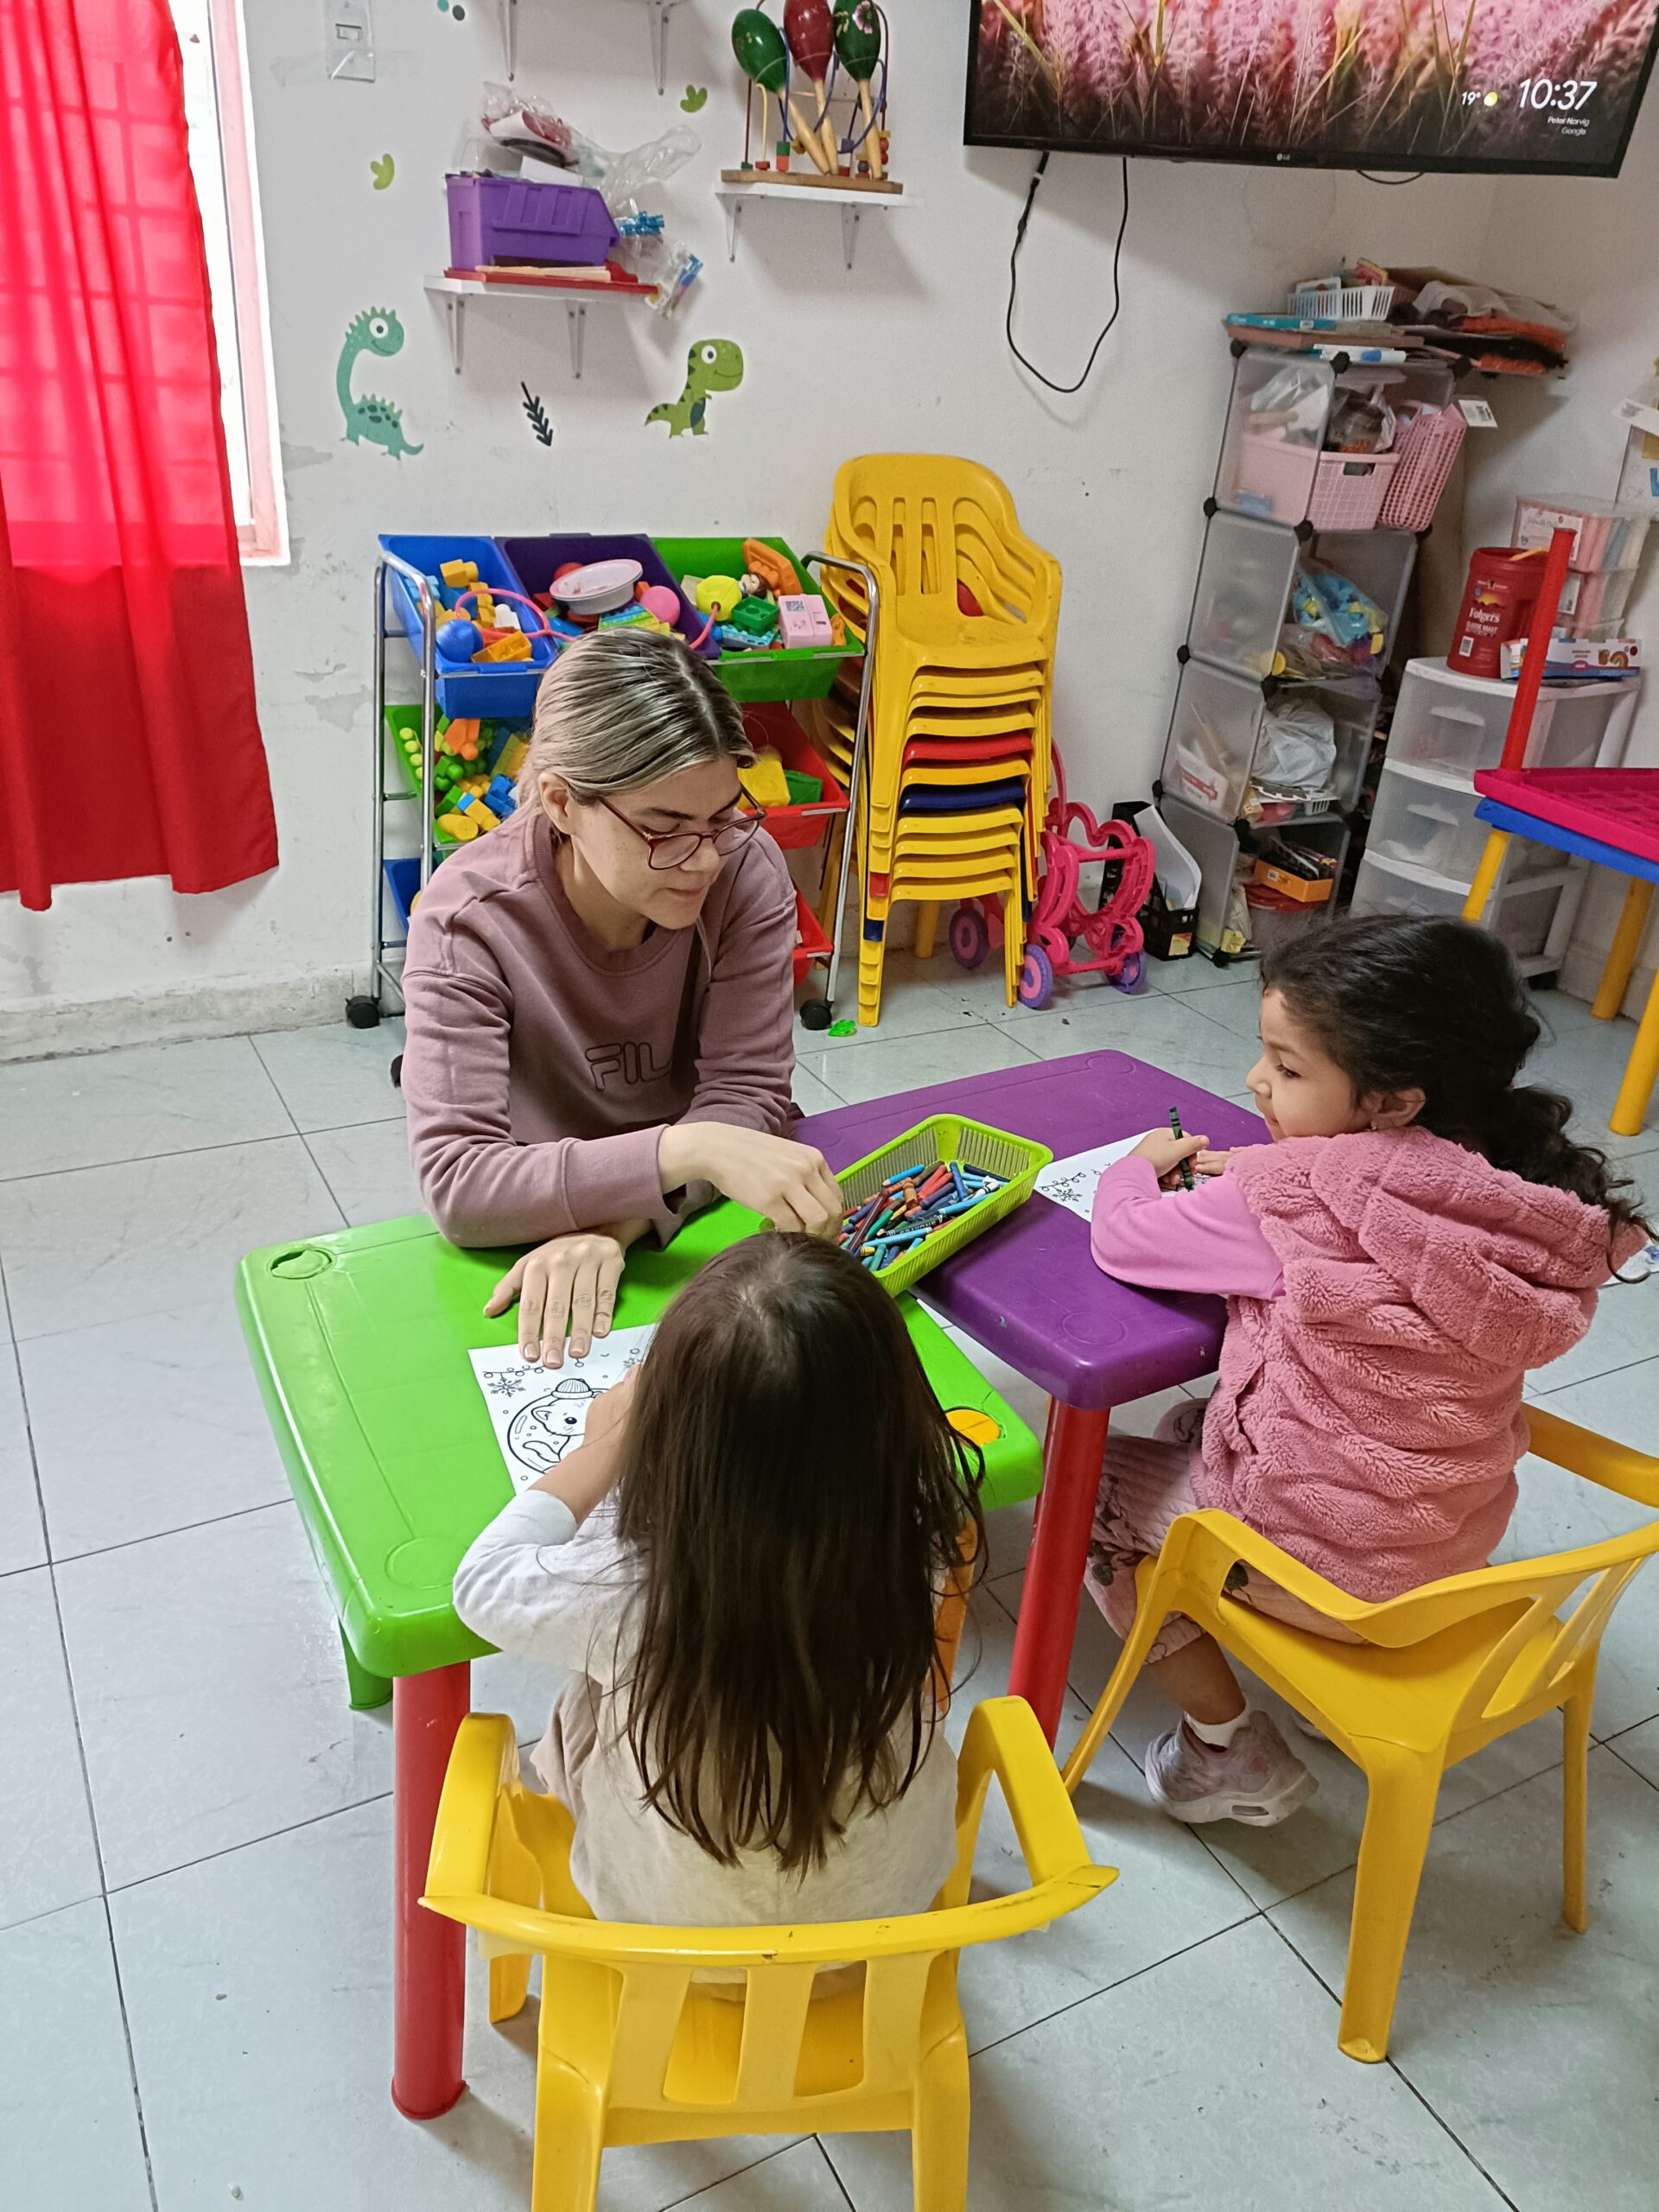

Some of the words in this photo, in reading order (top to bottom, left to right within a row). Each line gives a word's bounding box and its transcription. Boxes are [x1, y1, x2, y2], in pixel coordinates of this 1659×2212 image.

[1462, 92, 1481, 105] 19°
[1519, 79, 1598, 111] 10:37
[1548, 116, 1566, 125] Peter
[1560, 127, 1586, 136] Google
[1469, 607, 1500, 622] Folgers
[585, 1041, 672, 1091] FIL
